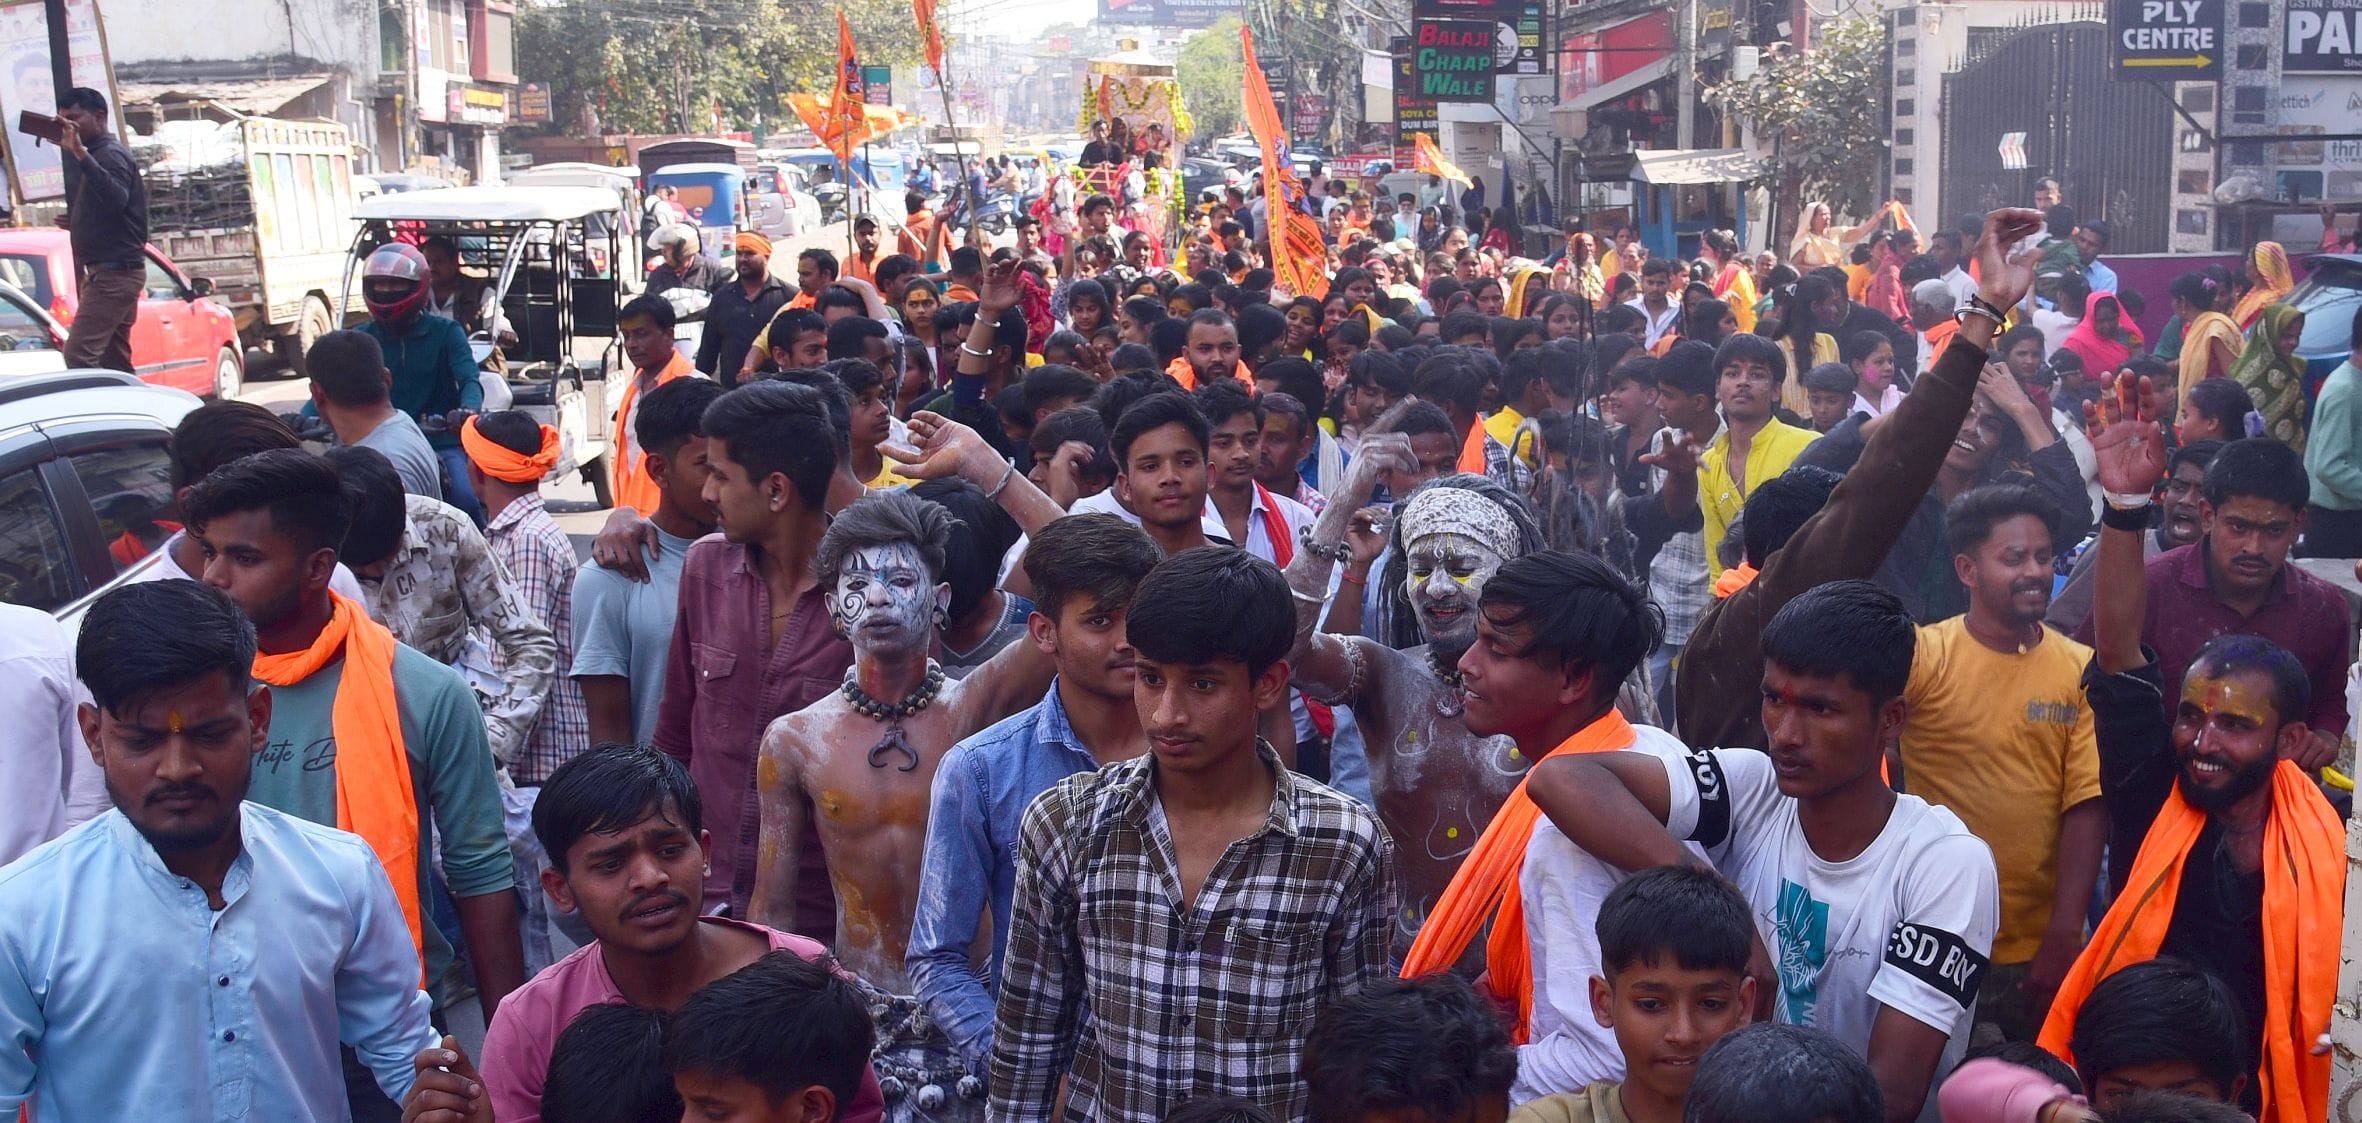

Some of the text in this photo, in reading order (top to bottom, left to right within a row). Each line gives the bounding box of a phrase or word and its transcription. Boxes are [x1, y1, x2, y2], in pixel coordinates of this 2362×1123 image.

[2142, 1, 2202, 24] PLY
[1418, 24, 1490, 46] BALAJI
[2122, 27, 2214, 51] CENTRE
[1418, 48, 1491, 71] CHAAP
[1423, 73, 1486, 95] WALE
[2280, 93, 2310, 109] ettich
[1400, 110, 1424, 118] SOYA
[1401, 121, 1420, 129] DUM
